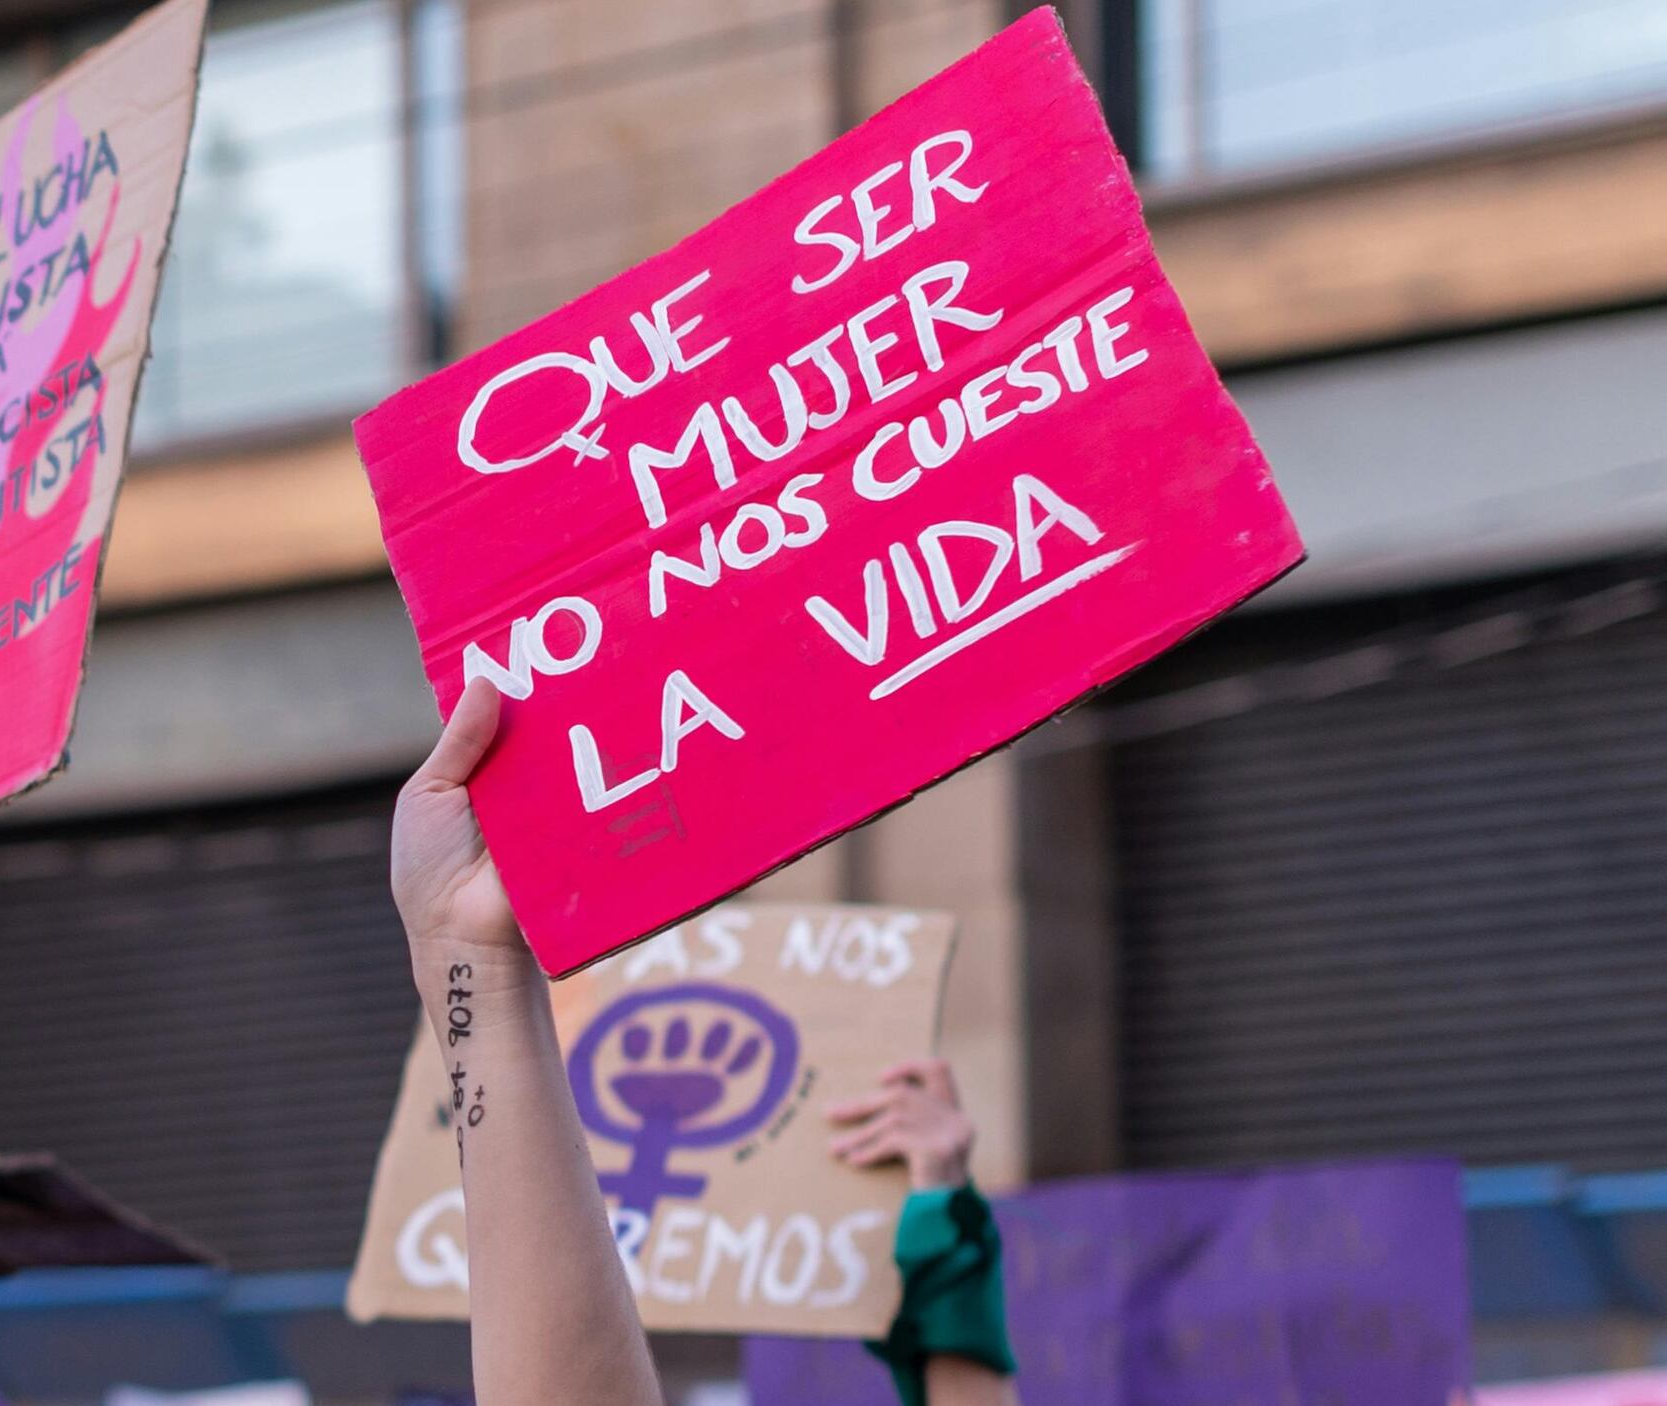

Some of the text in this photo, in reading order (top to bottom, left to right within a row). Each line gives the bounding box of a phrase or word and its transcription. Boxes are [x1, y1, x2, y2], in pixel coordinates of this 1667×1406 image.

[458, 130, 990, 475] QUE SER
[629, 260, 1004, 530] MUJER
[463, 287, 1150, 701] NO NOS CUESTE
[568, 473, 1105, 813] LA VIDA
[447, 963, 473, 1048] 9073
[589, 908, 918, 988] AS NOS
[394, 1187, 887, 1307] QREMOS
